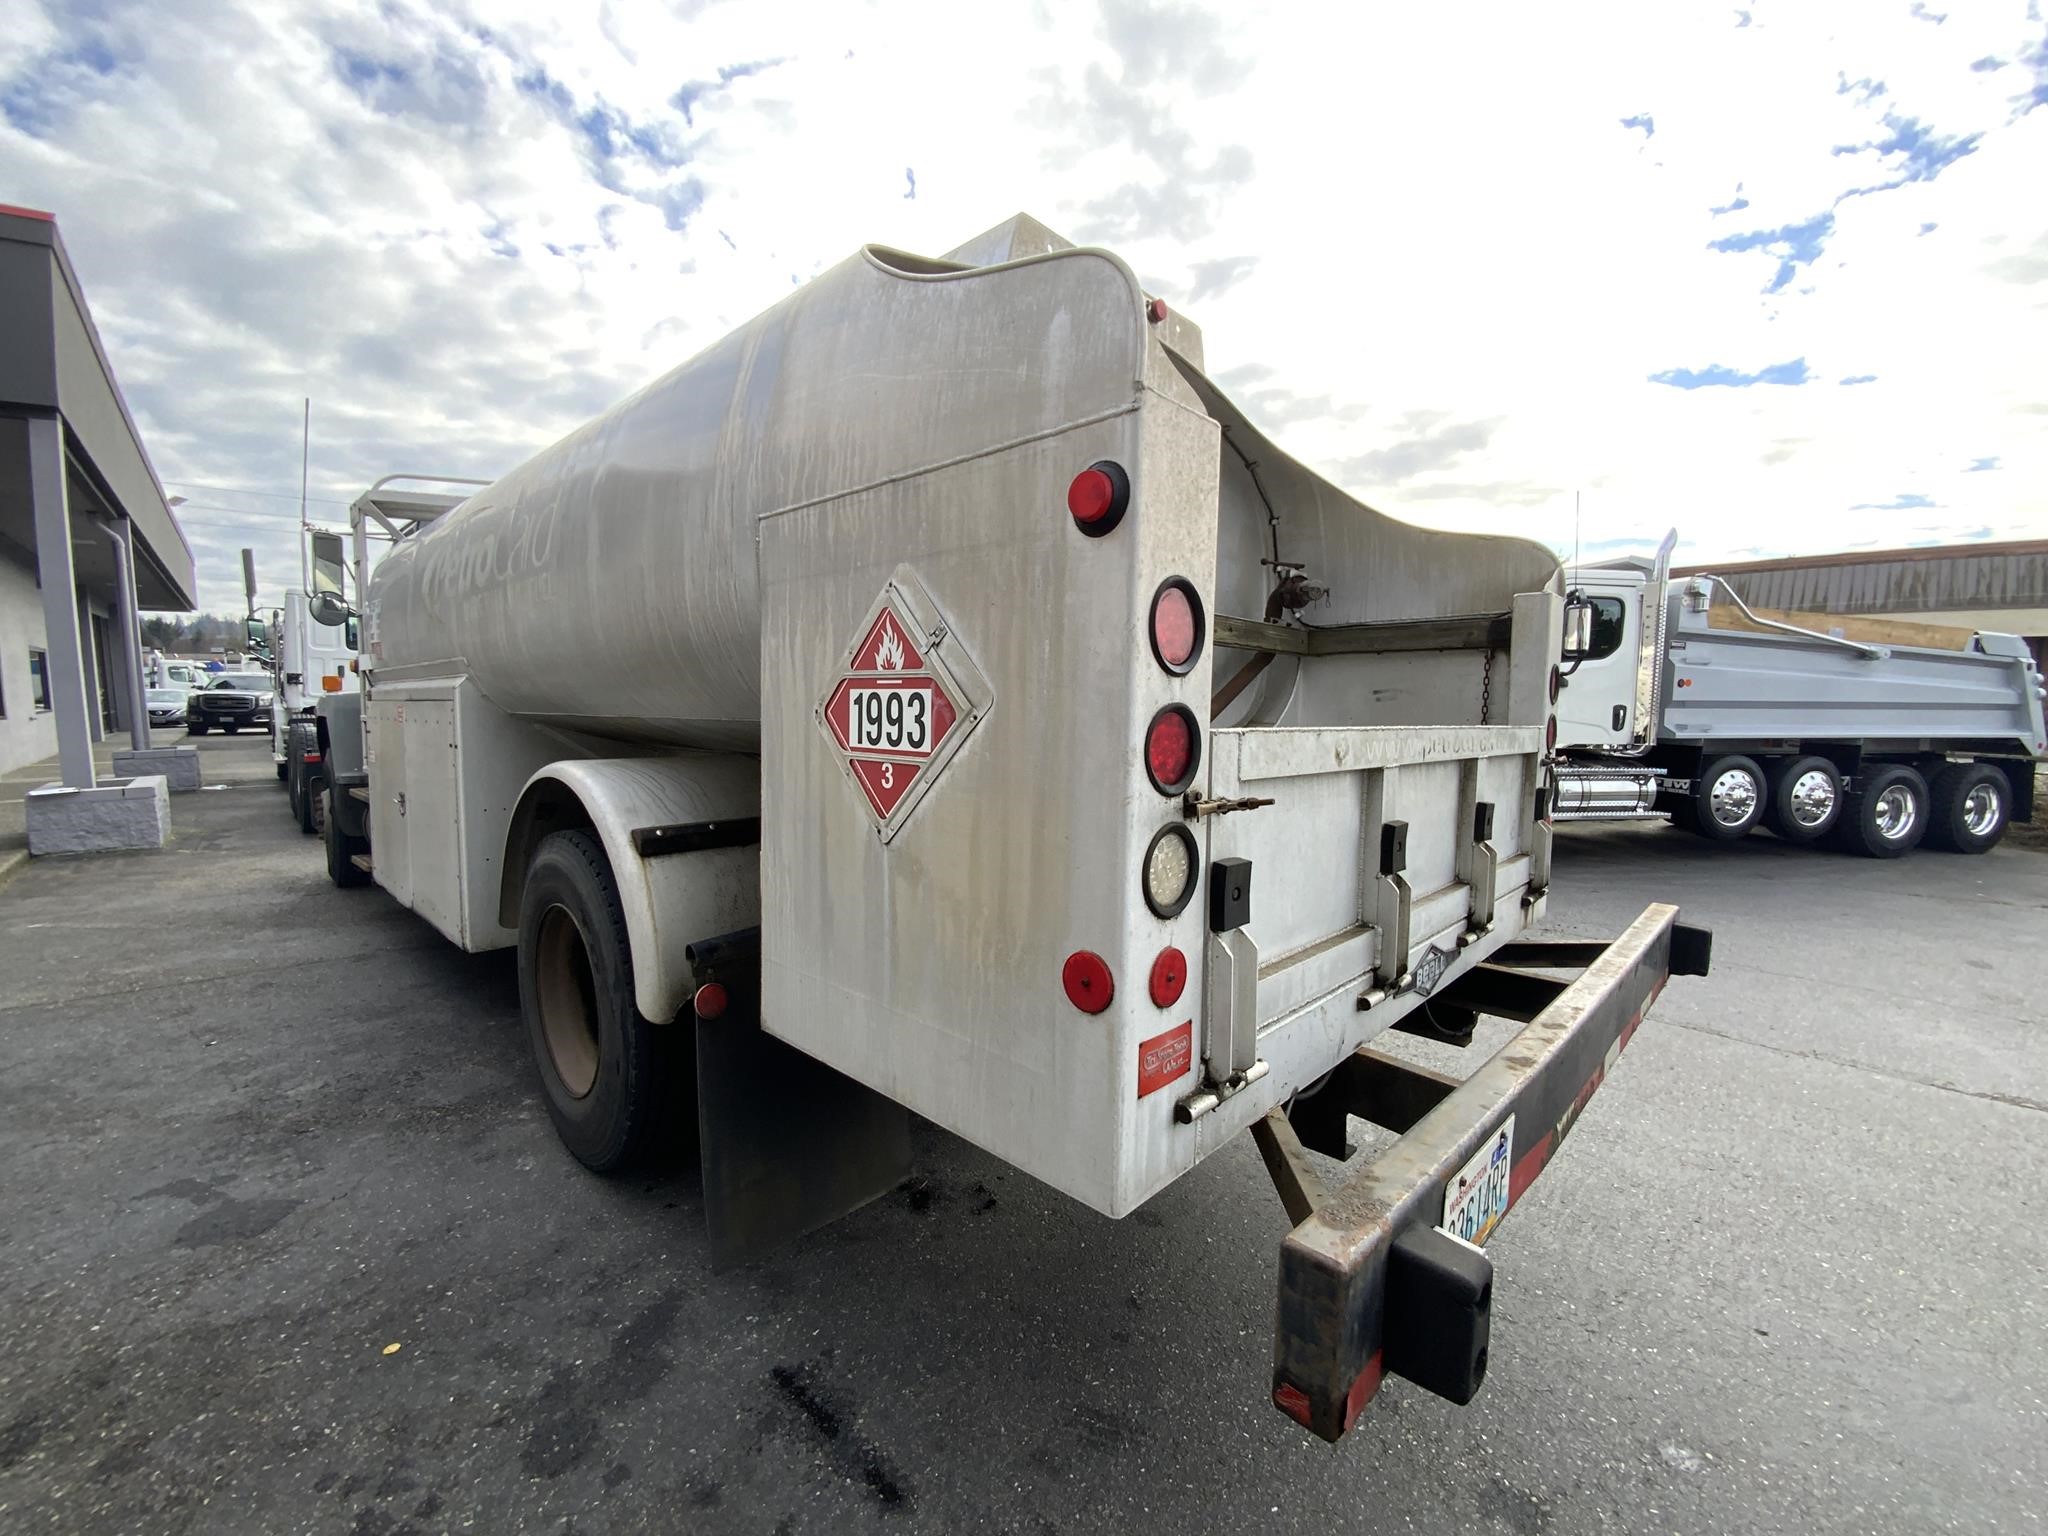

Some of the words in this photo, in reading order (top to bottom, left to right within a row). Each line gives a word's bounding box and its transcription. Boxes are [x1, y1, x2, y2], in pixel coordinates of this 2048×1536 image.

[854, 692, 926, 749] 1993
[881, 761, 895, 789] 3
[1449, 1163, 1489, 1215] WASHINGTON
